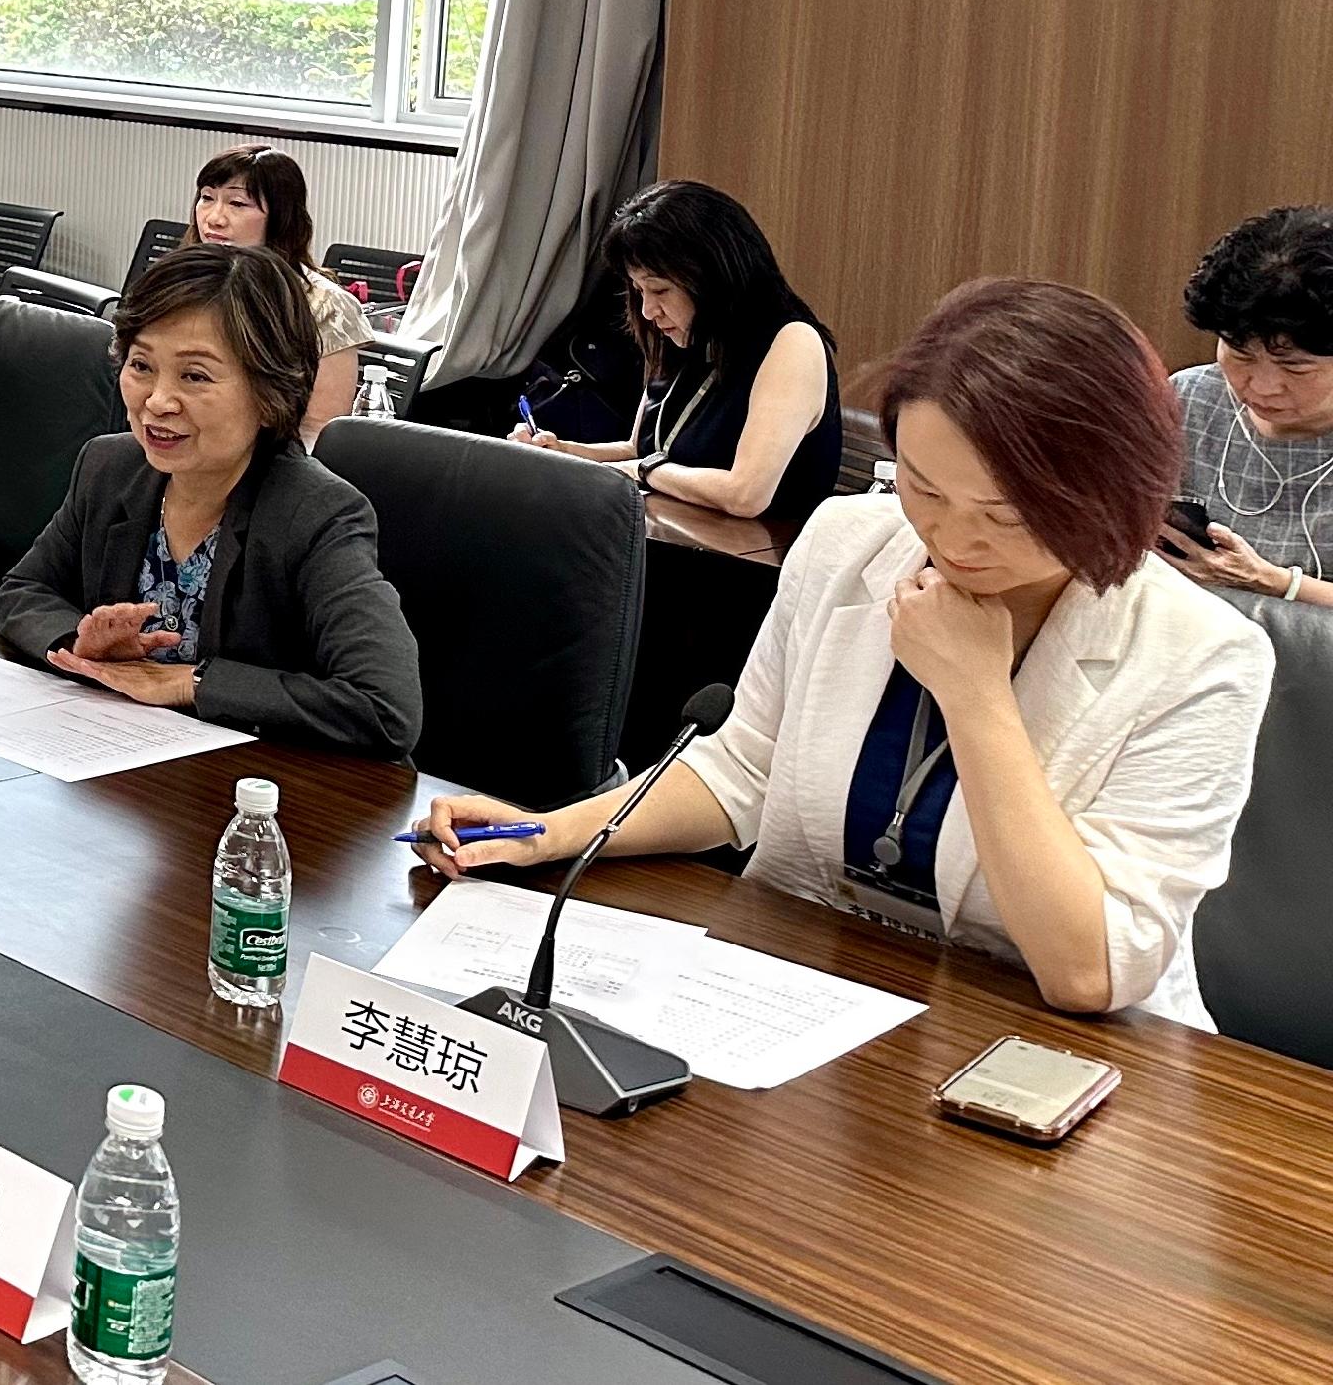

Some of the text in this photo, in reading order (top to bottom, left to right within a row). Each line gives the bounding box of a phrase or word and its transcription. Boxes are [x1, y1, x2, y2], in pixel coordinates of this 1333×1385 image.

[341, 1000, 488, 1093] 李慧琼
[496, 1001, 543, 1033] AKG
